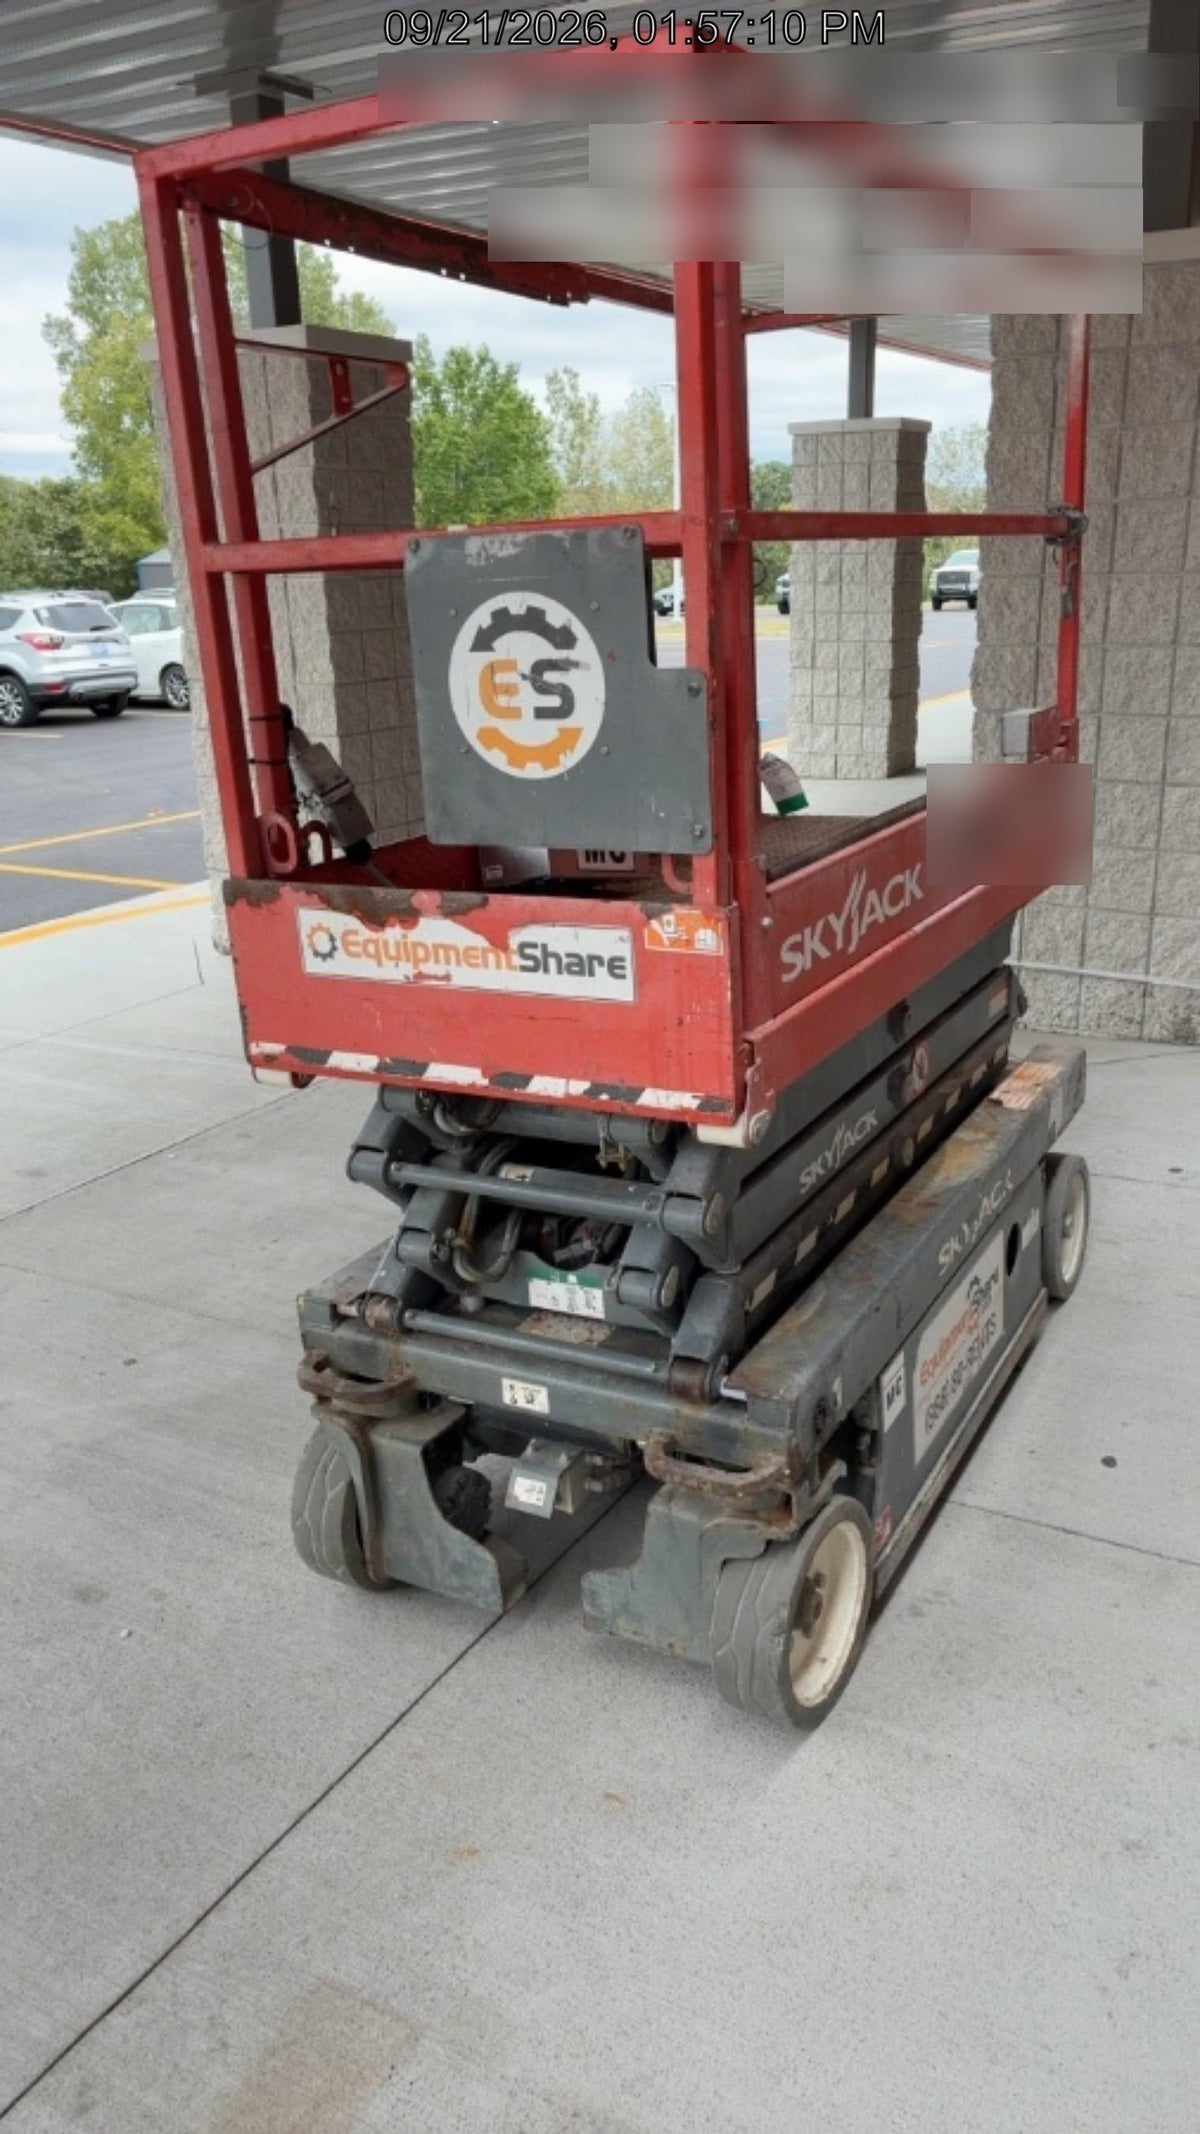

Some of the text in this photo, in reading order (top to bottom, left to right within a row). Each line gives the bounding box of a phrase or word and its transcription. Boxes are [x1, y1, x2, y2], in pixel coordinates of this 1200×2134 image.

[479, 657, 582, 720] ES
[341, 928, 628, 981] EquipmentShare
[779, 862, 925, 984] SKYJACK
[798, 1108, 880, 1195] SKYJACK
